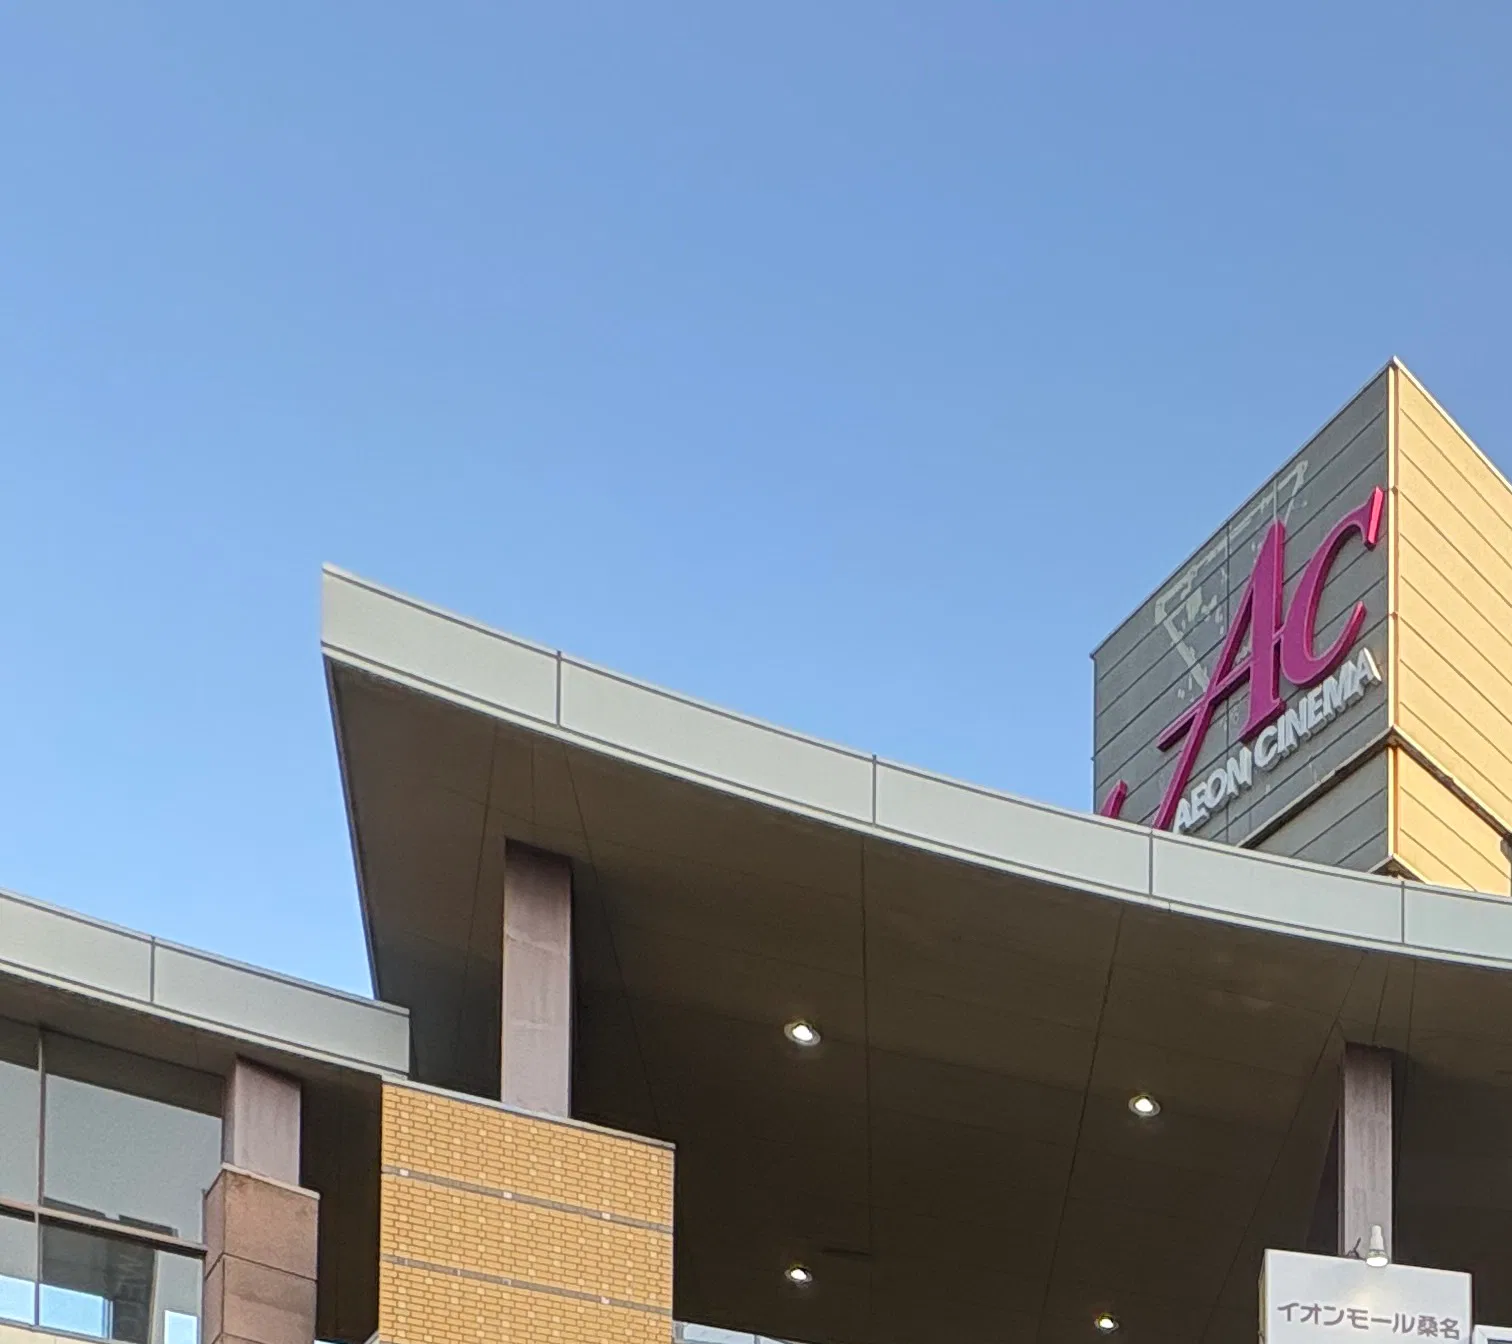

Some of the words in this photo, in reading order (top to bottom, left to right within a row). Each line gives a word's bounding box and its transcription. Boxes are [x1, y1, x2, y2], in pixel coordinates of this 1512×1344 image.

[1173, 745, 1252, 834] AEON
[1254, 647, 1383, 771] CINEMA
[1277, 1301, 1461, 1341] イオンモール桑名
